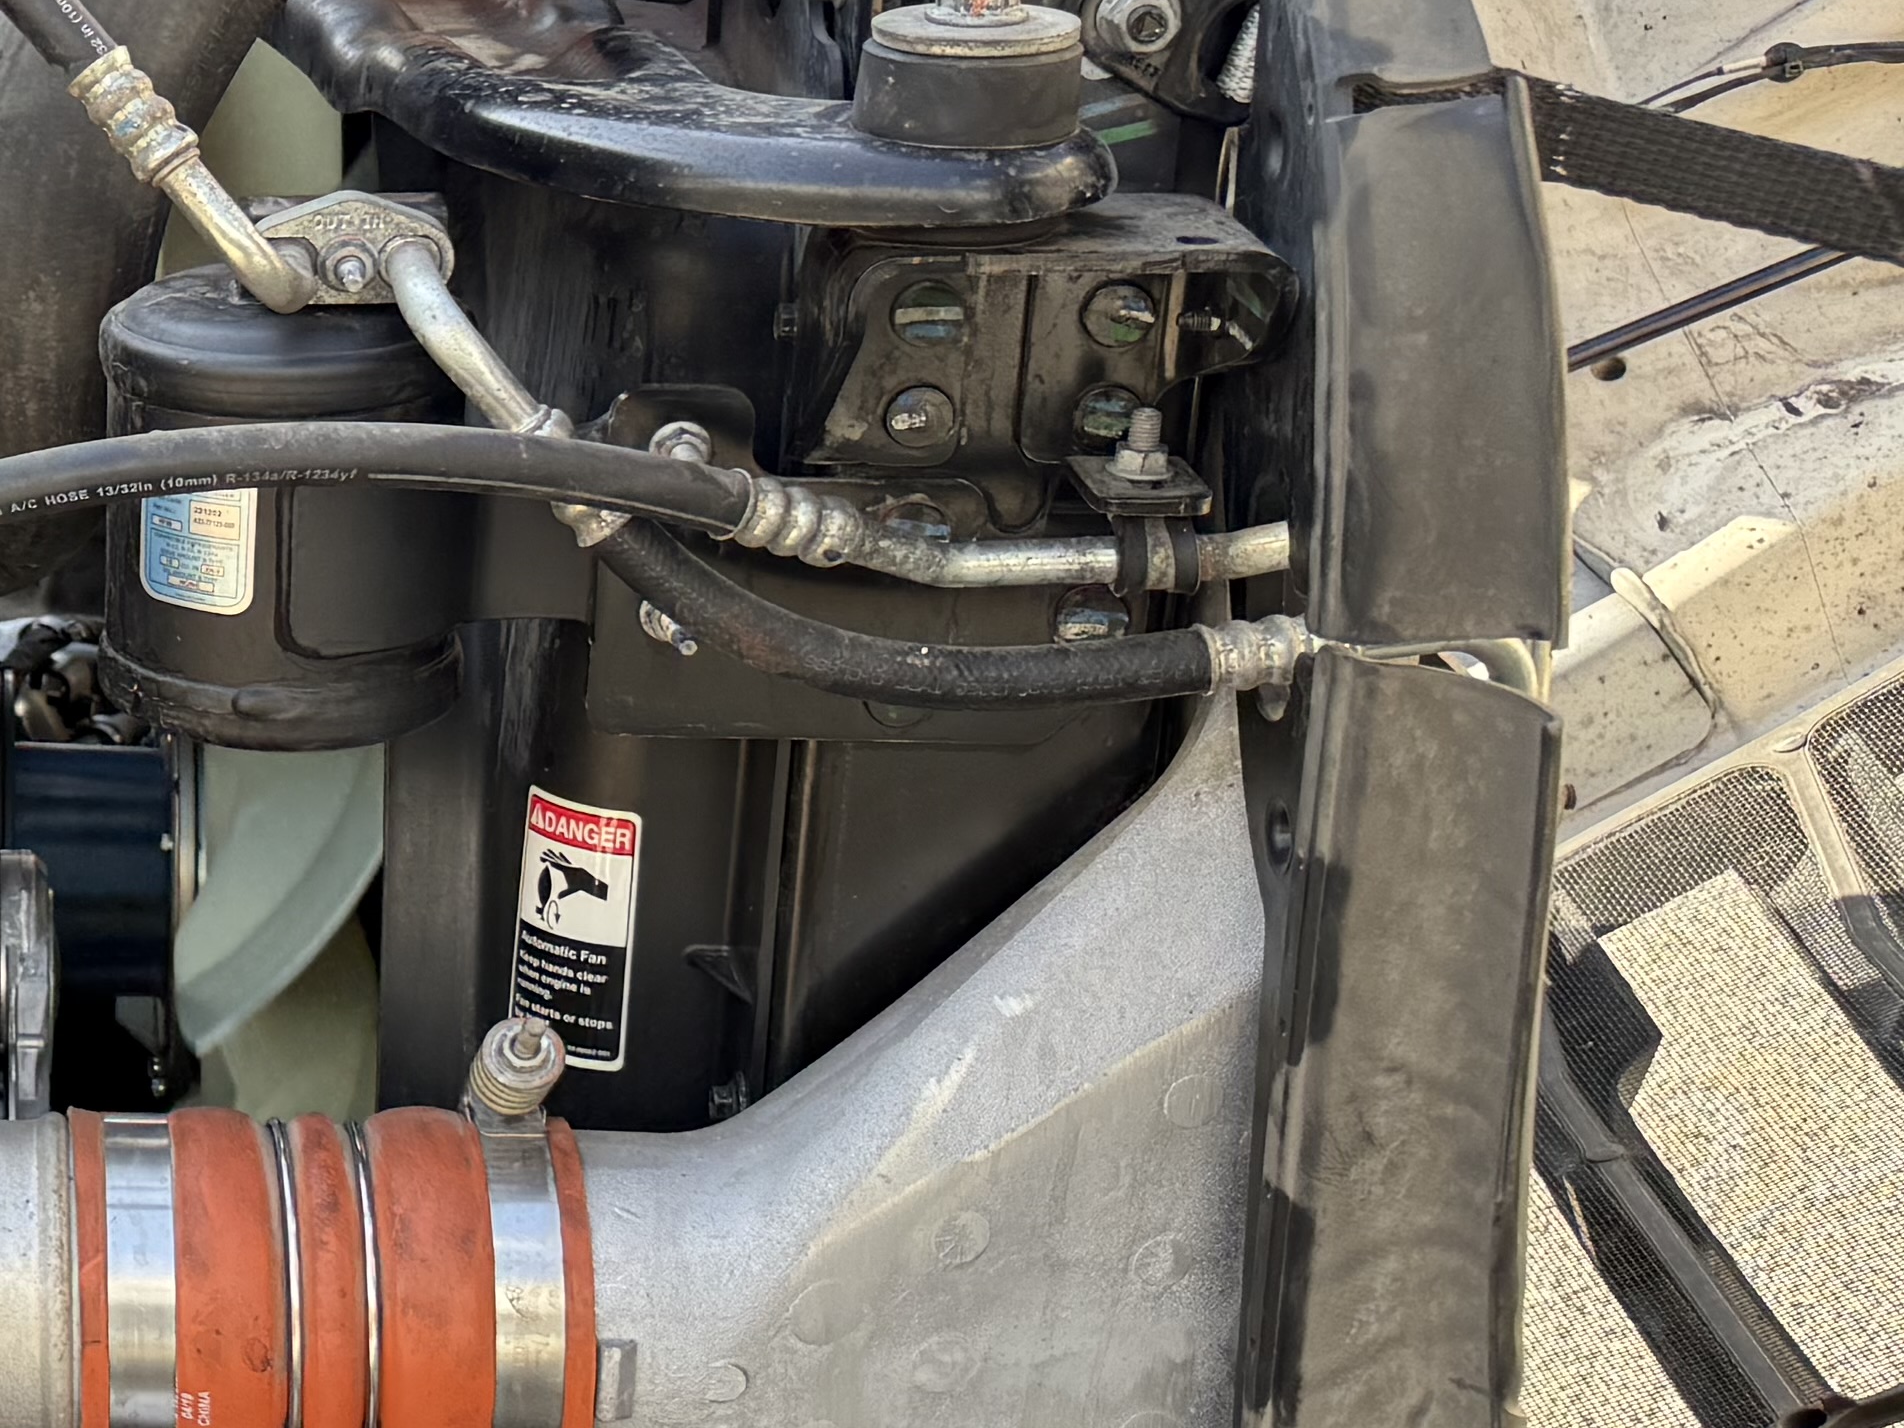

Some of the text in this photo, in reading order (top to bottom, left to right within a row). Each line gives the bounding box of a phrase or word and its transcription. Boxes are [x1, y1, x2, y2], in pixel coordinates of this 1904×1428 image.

[10, 499, 38, 514] A/C
[45, 489, 89, 508] HOSE
[158, 473, 218, 494] (10mm)
[544, 812, 631, 851] DANGER
[521, 930, 607, 965] Automatic Fan
[540, 958, 574, 979] hands
[576, 970, 608, 984] clear
[540, 974, 577, 994] engine
[564, 1014, 576, 1024] or
